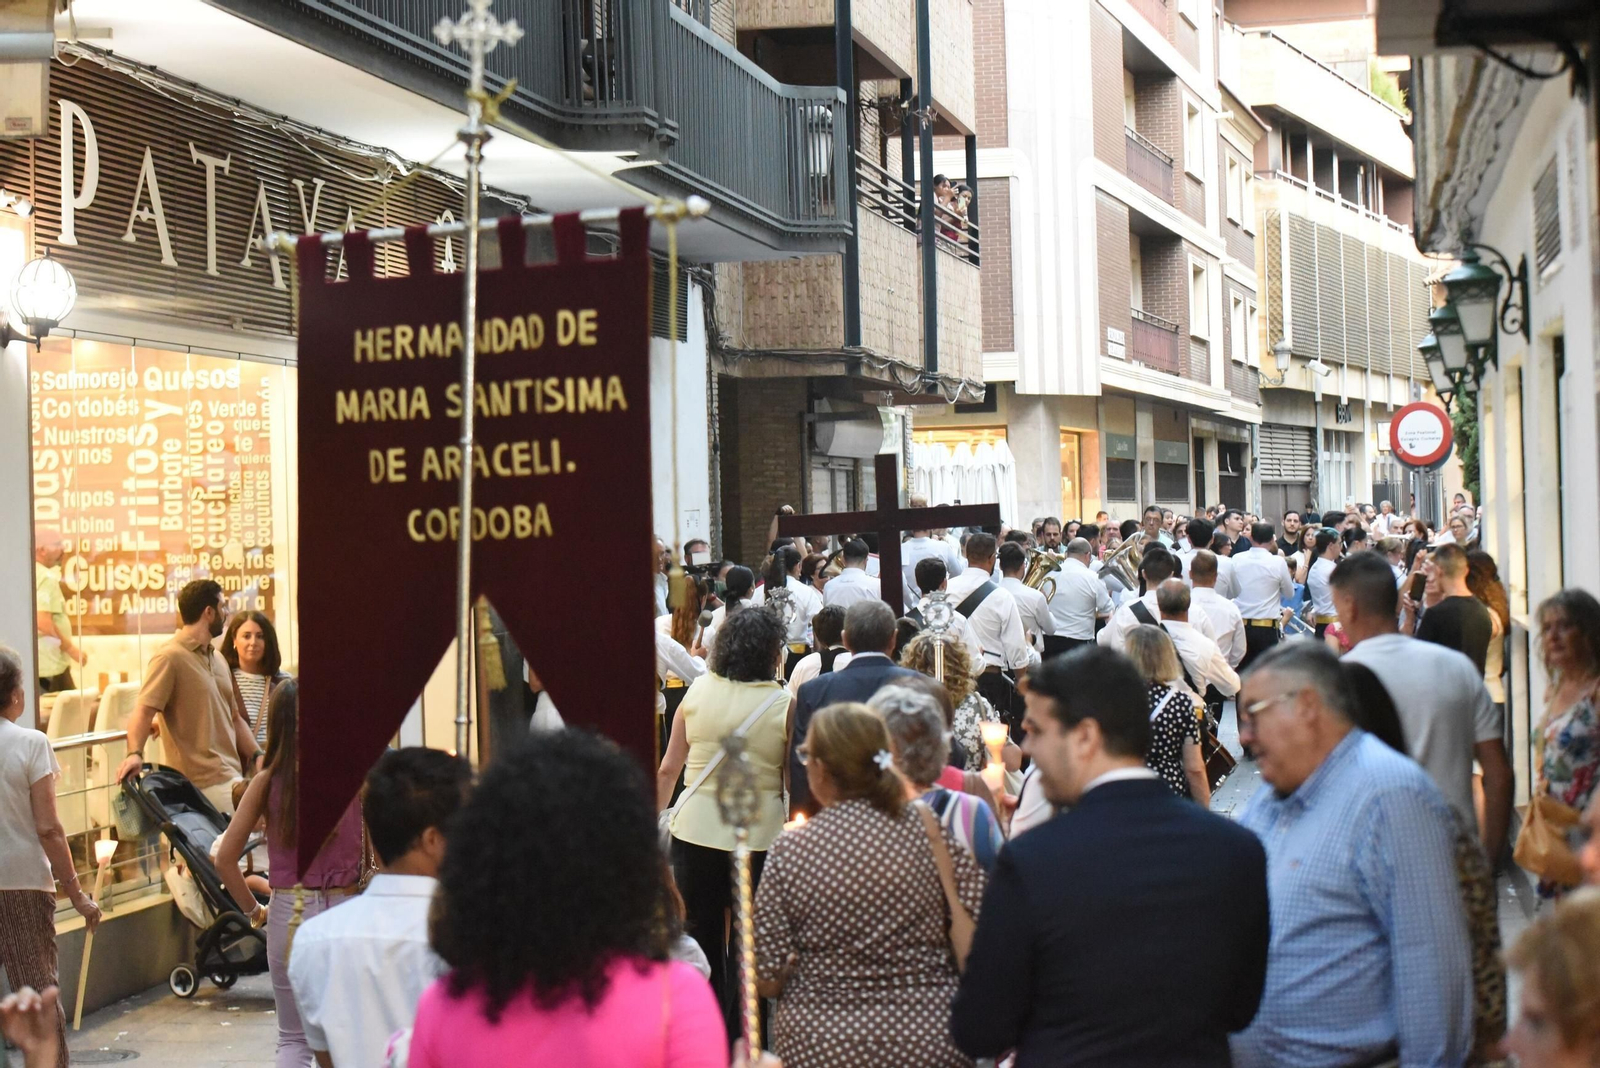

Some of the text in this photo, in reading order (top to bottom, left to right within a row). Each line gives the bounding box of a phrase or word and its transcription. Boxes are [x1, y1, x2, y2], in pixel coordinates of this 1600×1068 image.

[353, 308, 599, 363] HERMANDAD DE
[42, 368, 139, 392] Salmorejo
[143, 366, 239, 392] Quesos
[207, 400, 257, 418] Verde
[335, 375, 629, 424] MARIA SANTISIMA
[43, 425, 127, 446] Nuestros
[233, 418, 261, 434] que
[233, 435, 254, 453] te
[233, 453, 271, 466] quiero
[368, 438, 577, 485] DE ARACELI.
[61, 467, 75, 489] y
[121, 398, 183, 552] Fritos y
[160, 437, 183, 531] Barbate
[203, 420, 228, 549] cuchareo
[62, 489, 115, 511] tapas
[255, 470, 272, 548] coquinas
[243, 530, 256, 548] de
[64, 554, 166, 593] Guisos
[173, 565, 191, 578] de
[65, 593, 179, 616] de la Abuel
